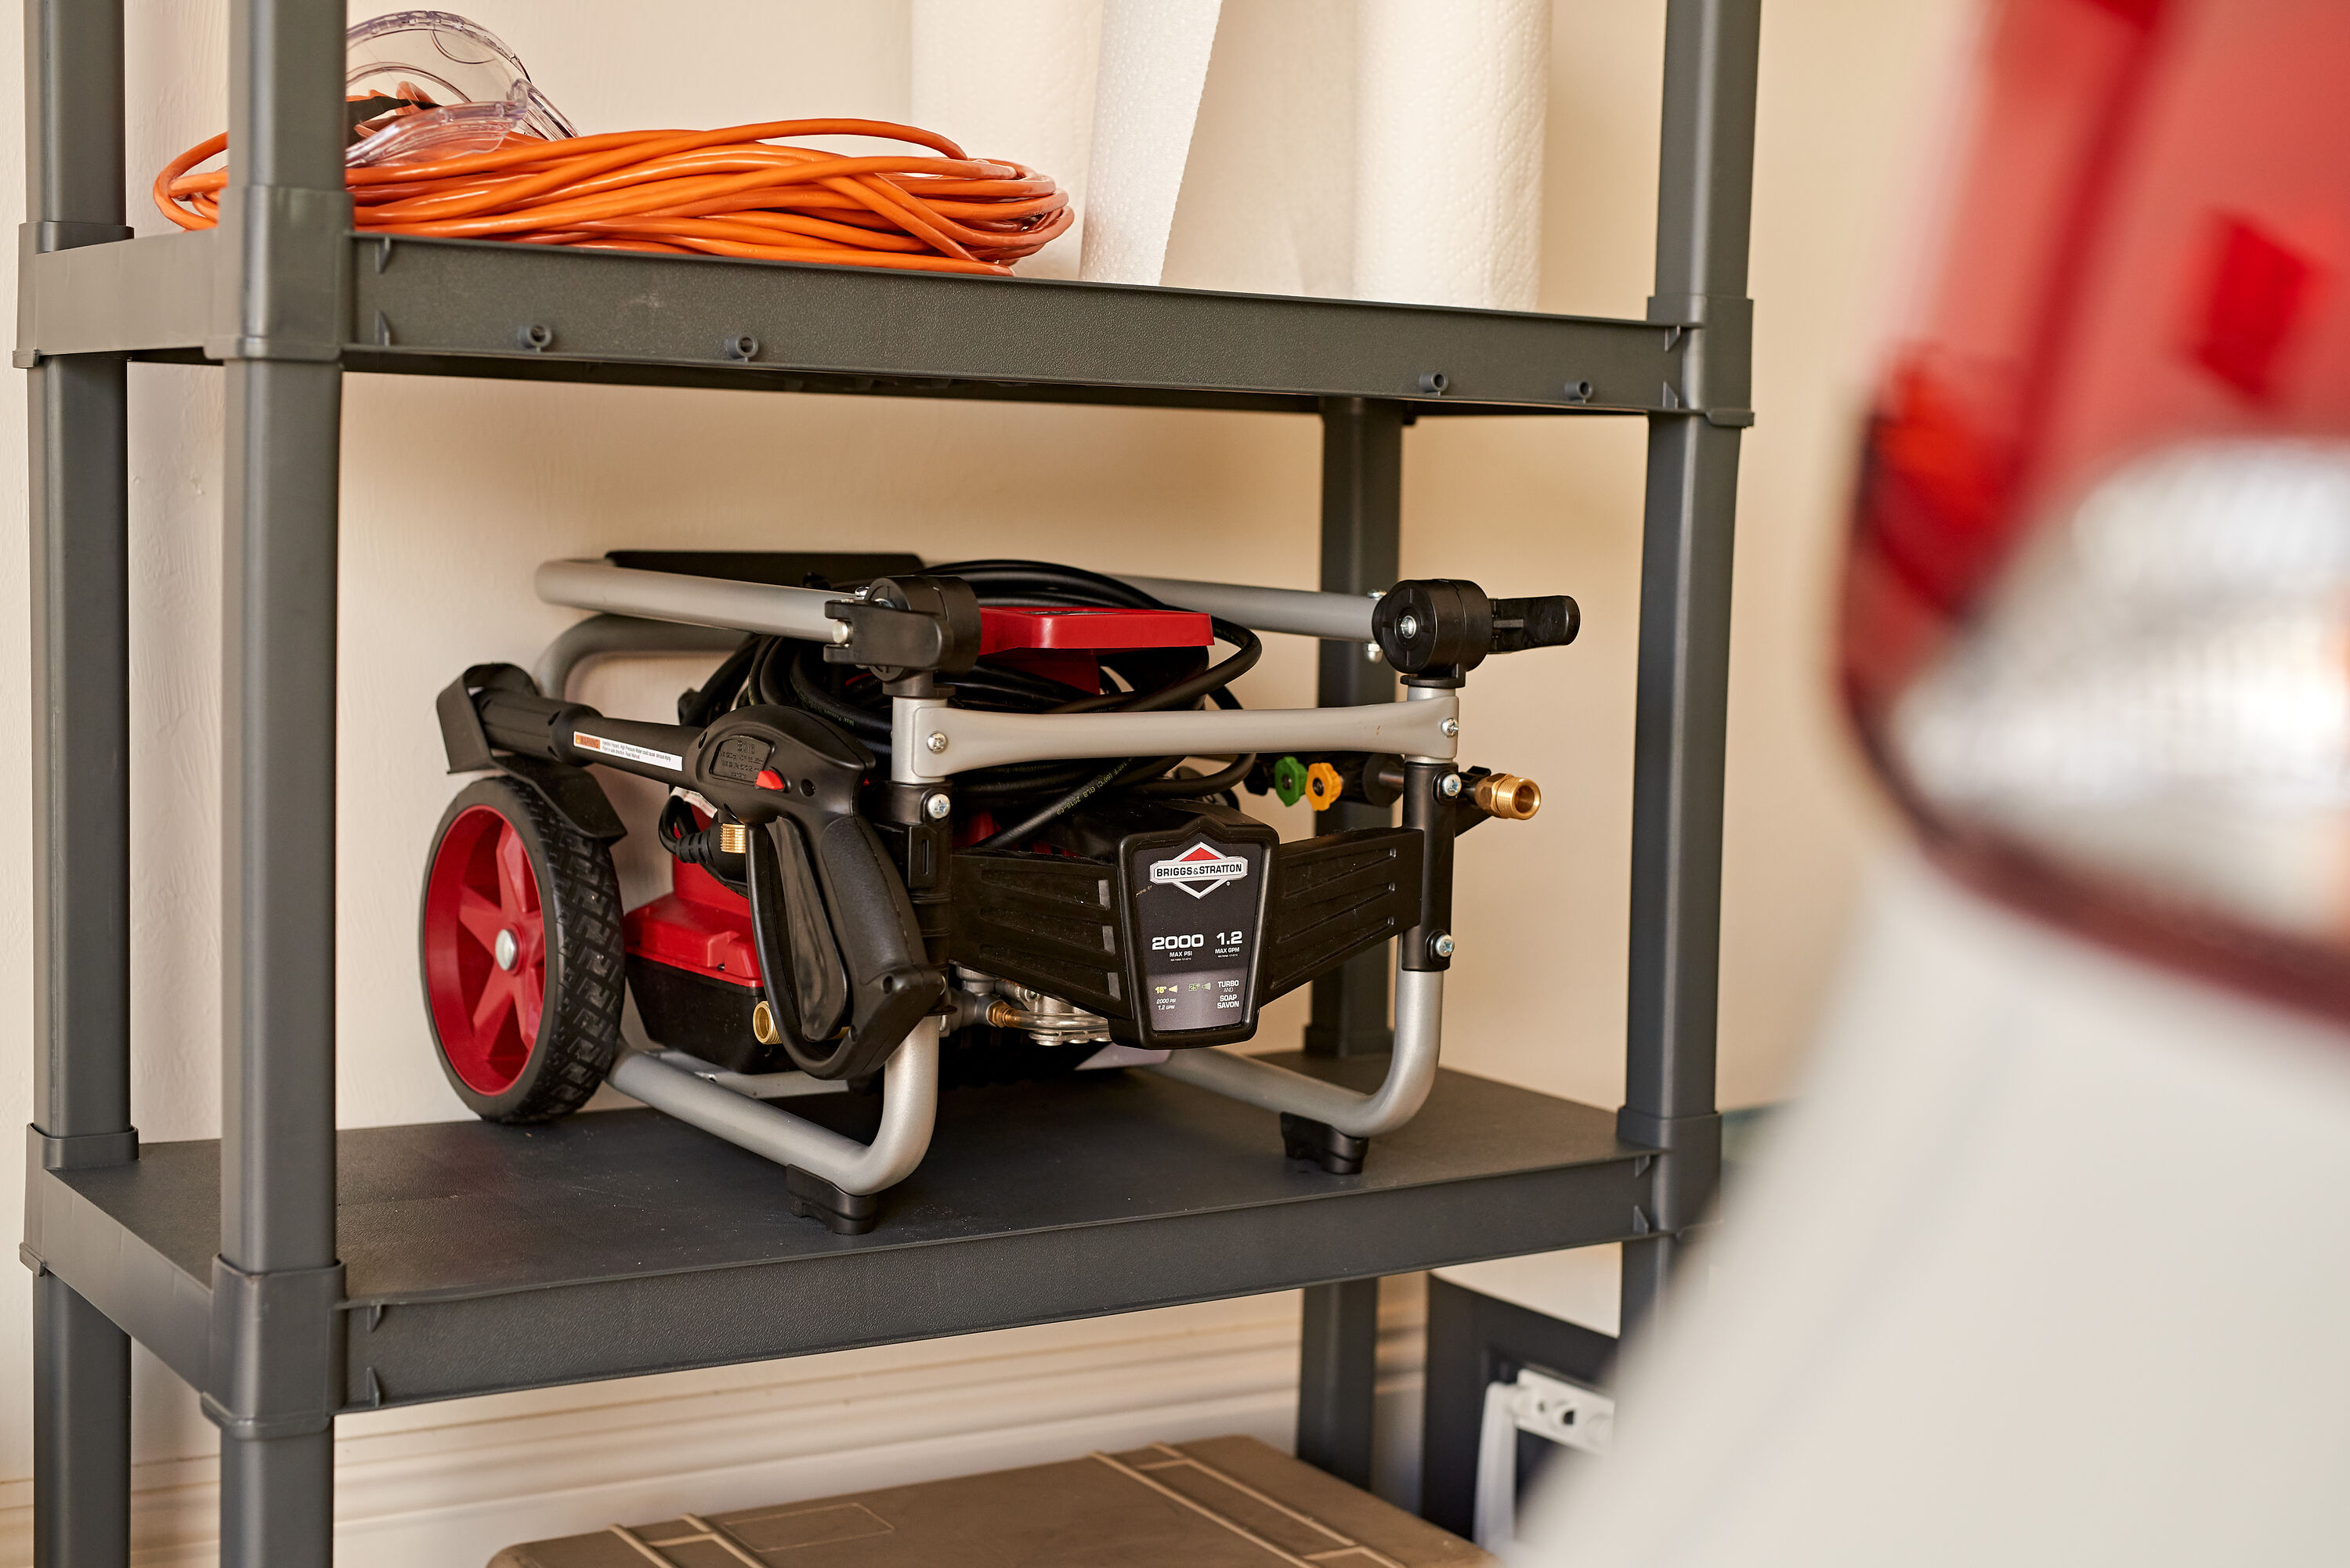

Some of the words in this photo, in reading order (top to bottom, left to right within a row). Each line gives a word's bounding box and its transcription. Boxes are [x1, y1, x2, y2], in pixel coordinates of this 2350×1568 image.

[1152, 934, 1204, 950] 2000
[1216, 930, 1243, 945] 1.2
[1217, 1000, 1240, 1009] SAVON
